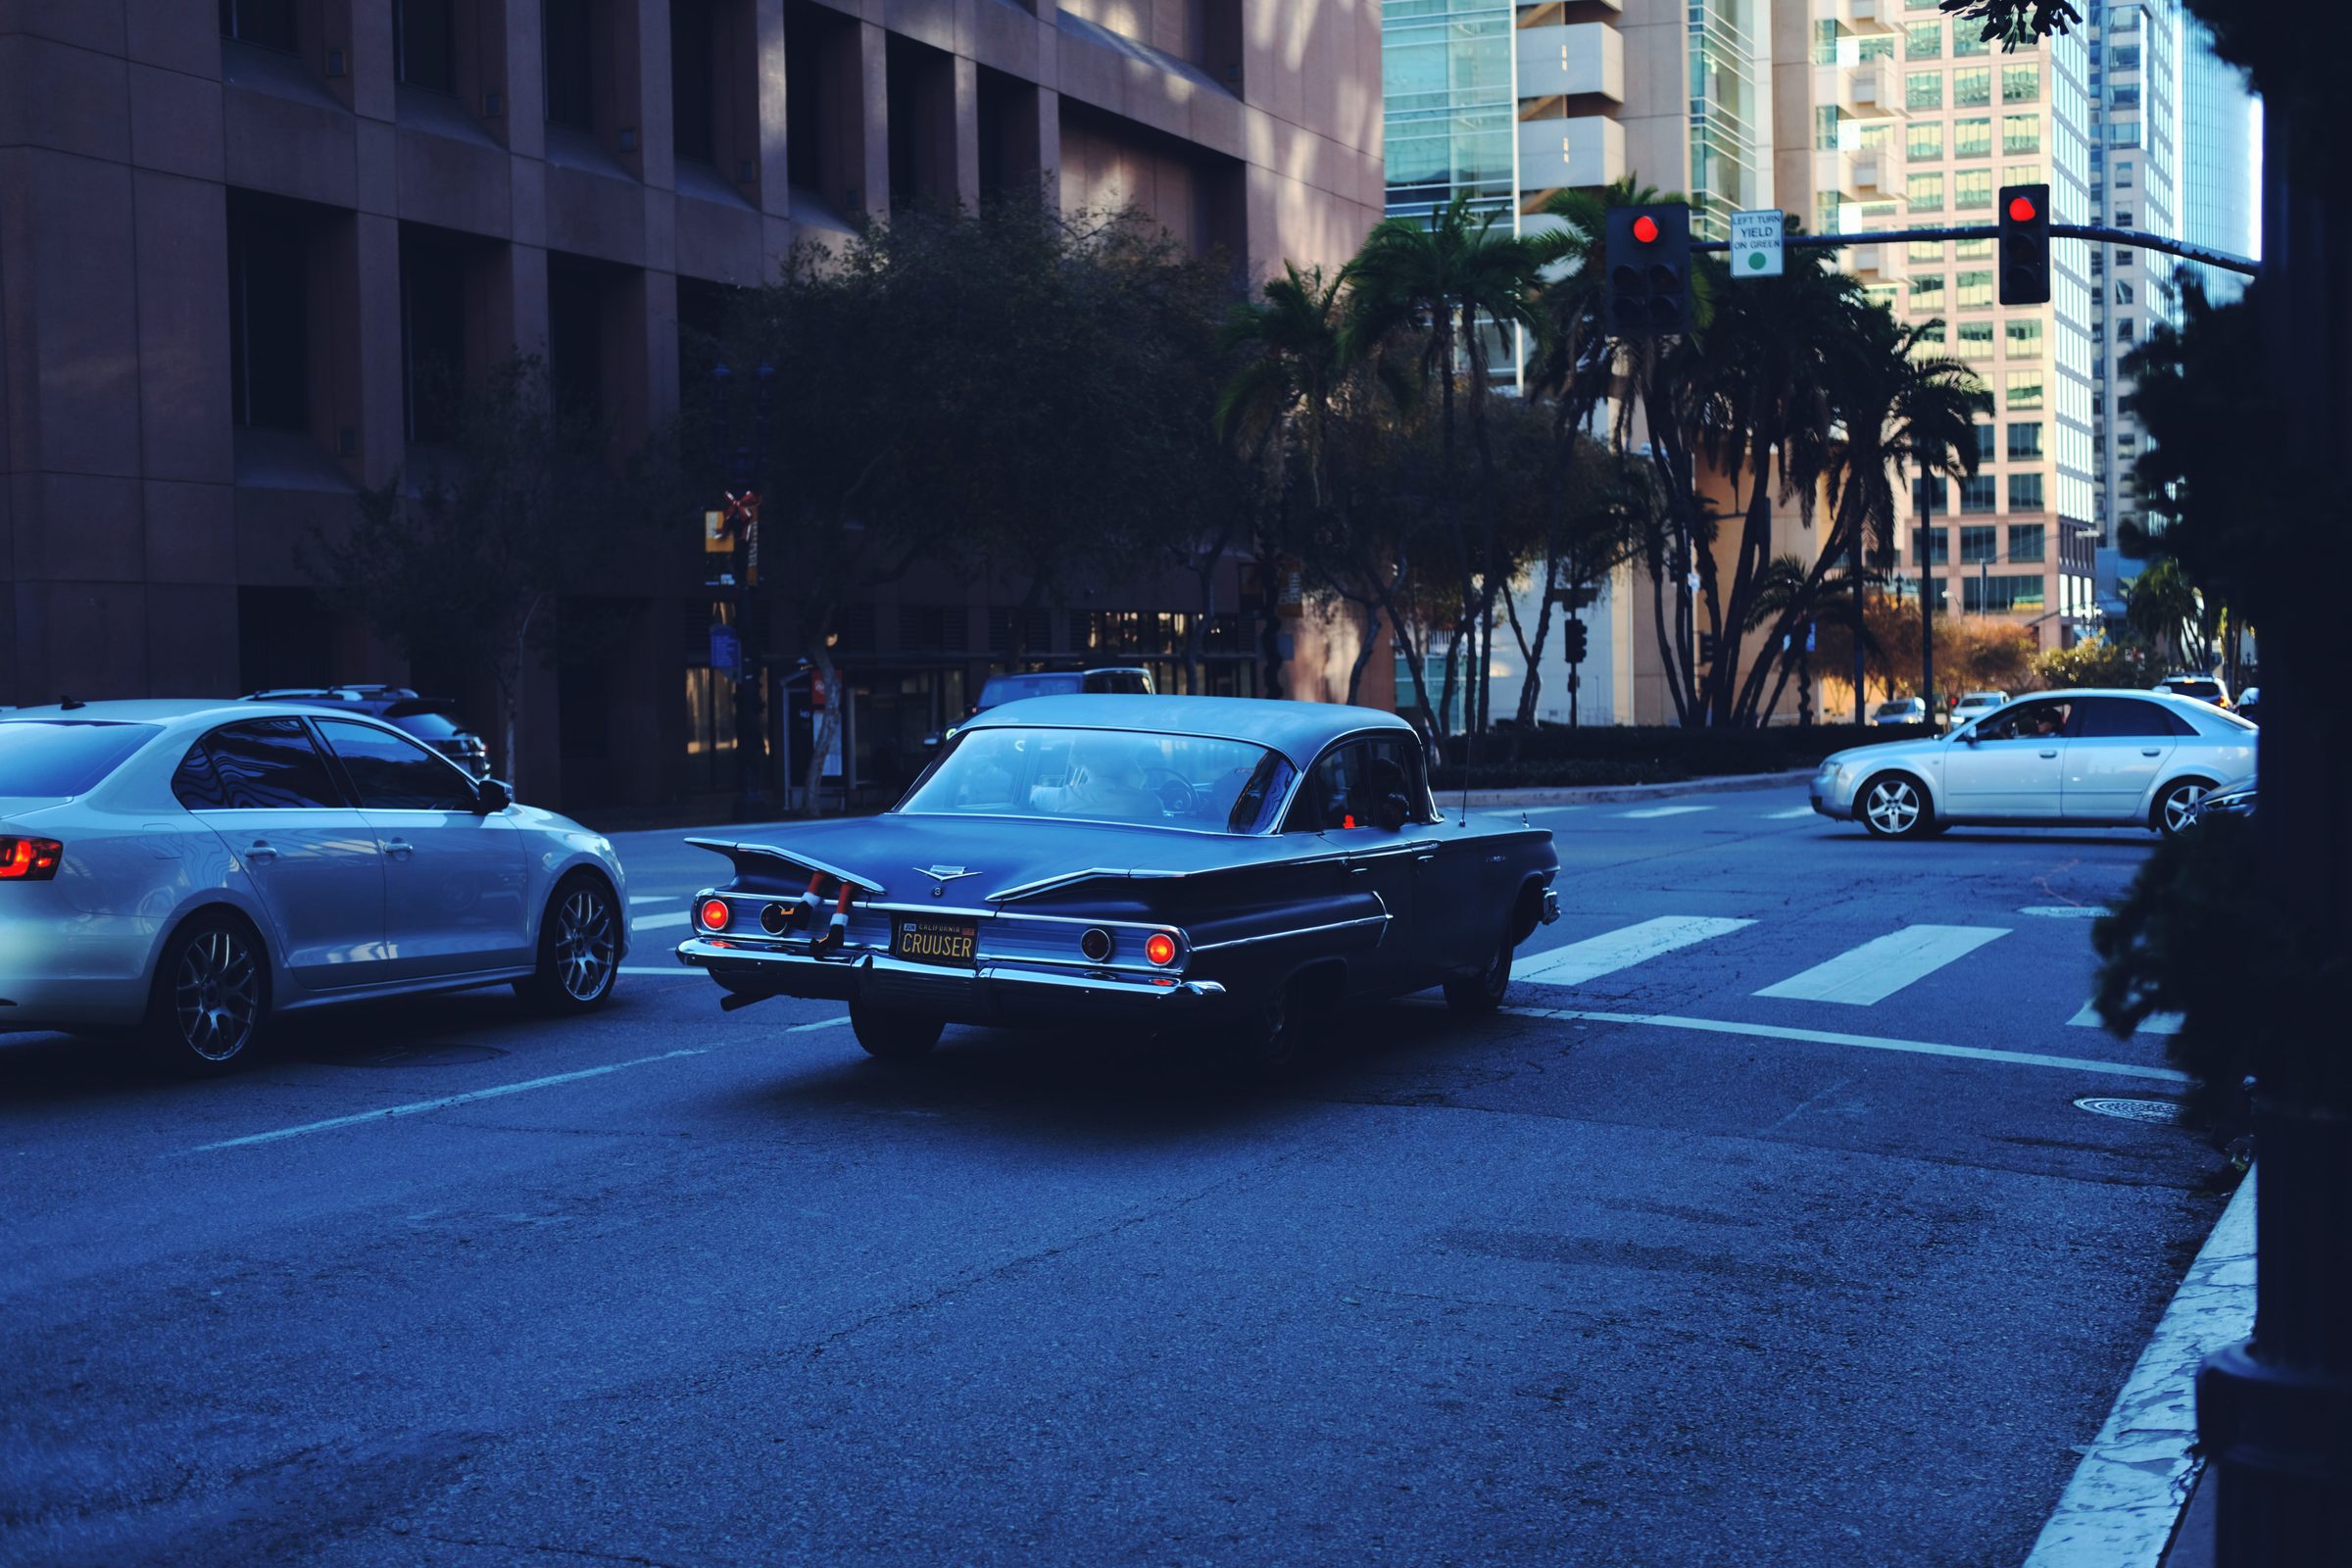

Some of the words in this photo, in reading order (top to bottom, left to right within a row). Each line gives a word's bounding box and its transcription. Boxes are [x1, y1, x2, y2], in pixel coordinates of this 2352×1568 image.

[1757, 215, 1781, 224] TURN
[1740, 226, 1773, 238] YIELD
[1734, 241, 1747, 250] ON
[1750, 239, 1781, 250] GREEN
[918, 924, 960, 933] CALIFORNIA
[902, 933, 972, 957] CRUUSER
